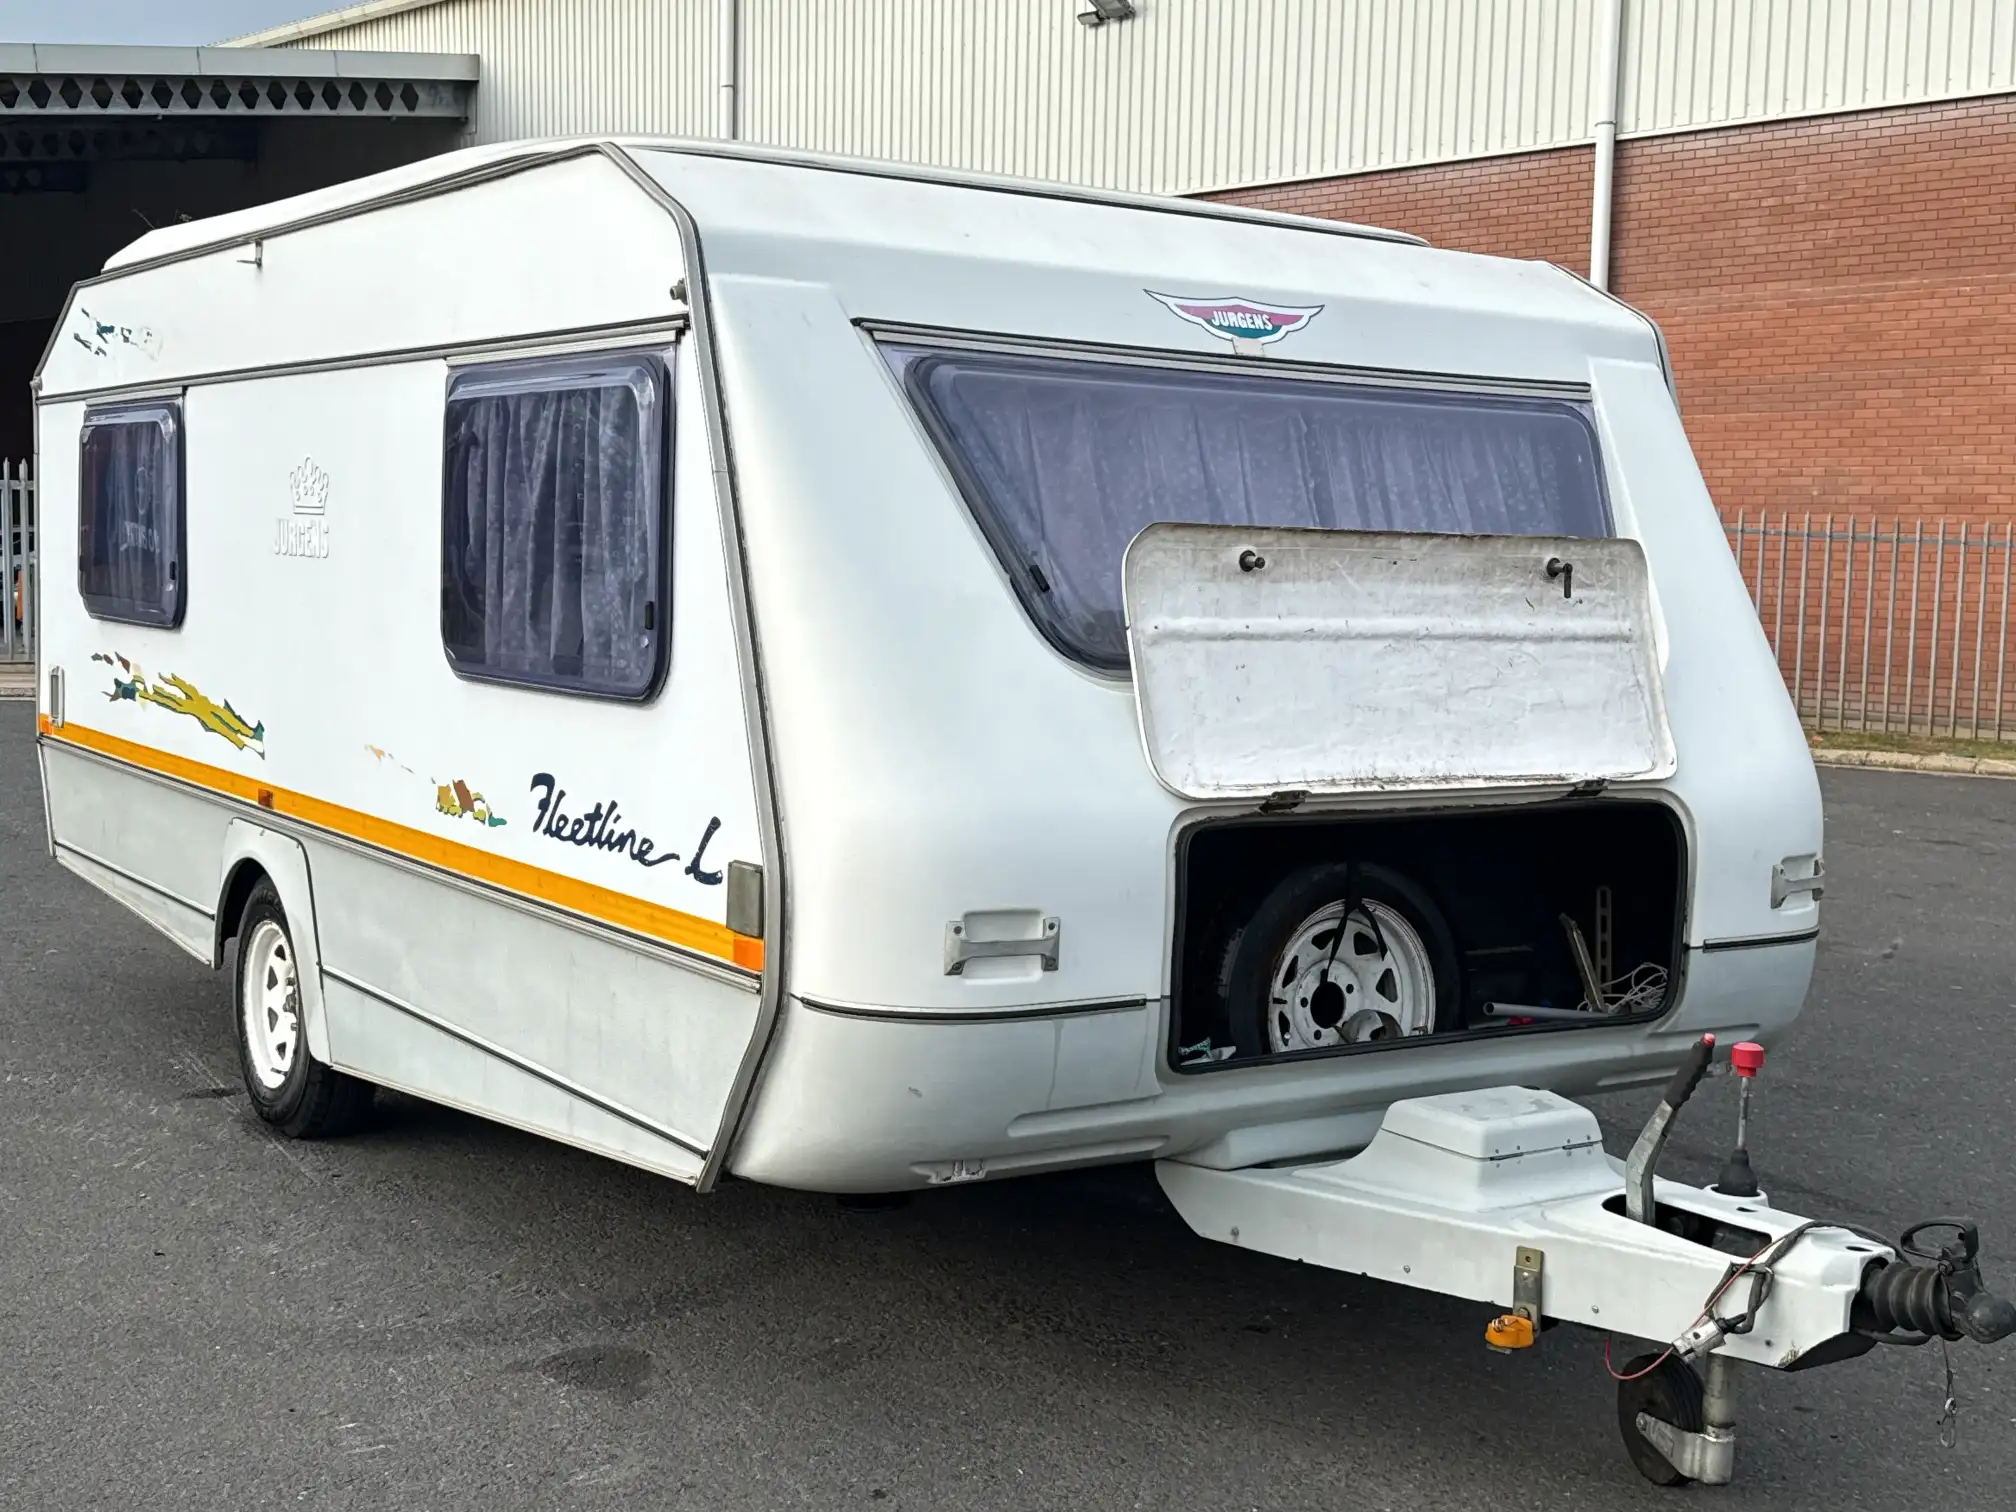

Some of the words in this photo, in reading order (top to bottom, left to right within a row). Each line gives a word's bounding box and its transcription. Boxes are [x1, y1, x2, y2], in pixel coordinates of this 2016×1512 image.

[1211, 310, 1273, 331] JURGENS
[274, 518, 329, 559] JURGENS
[530, 772, 680, 867] Fleetline
[685, 816, 723, 885] L
